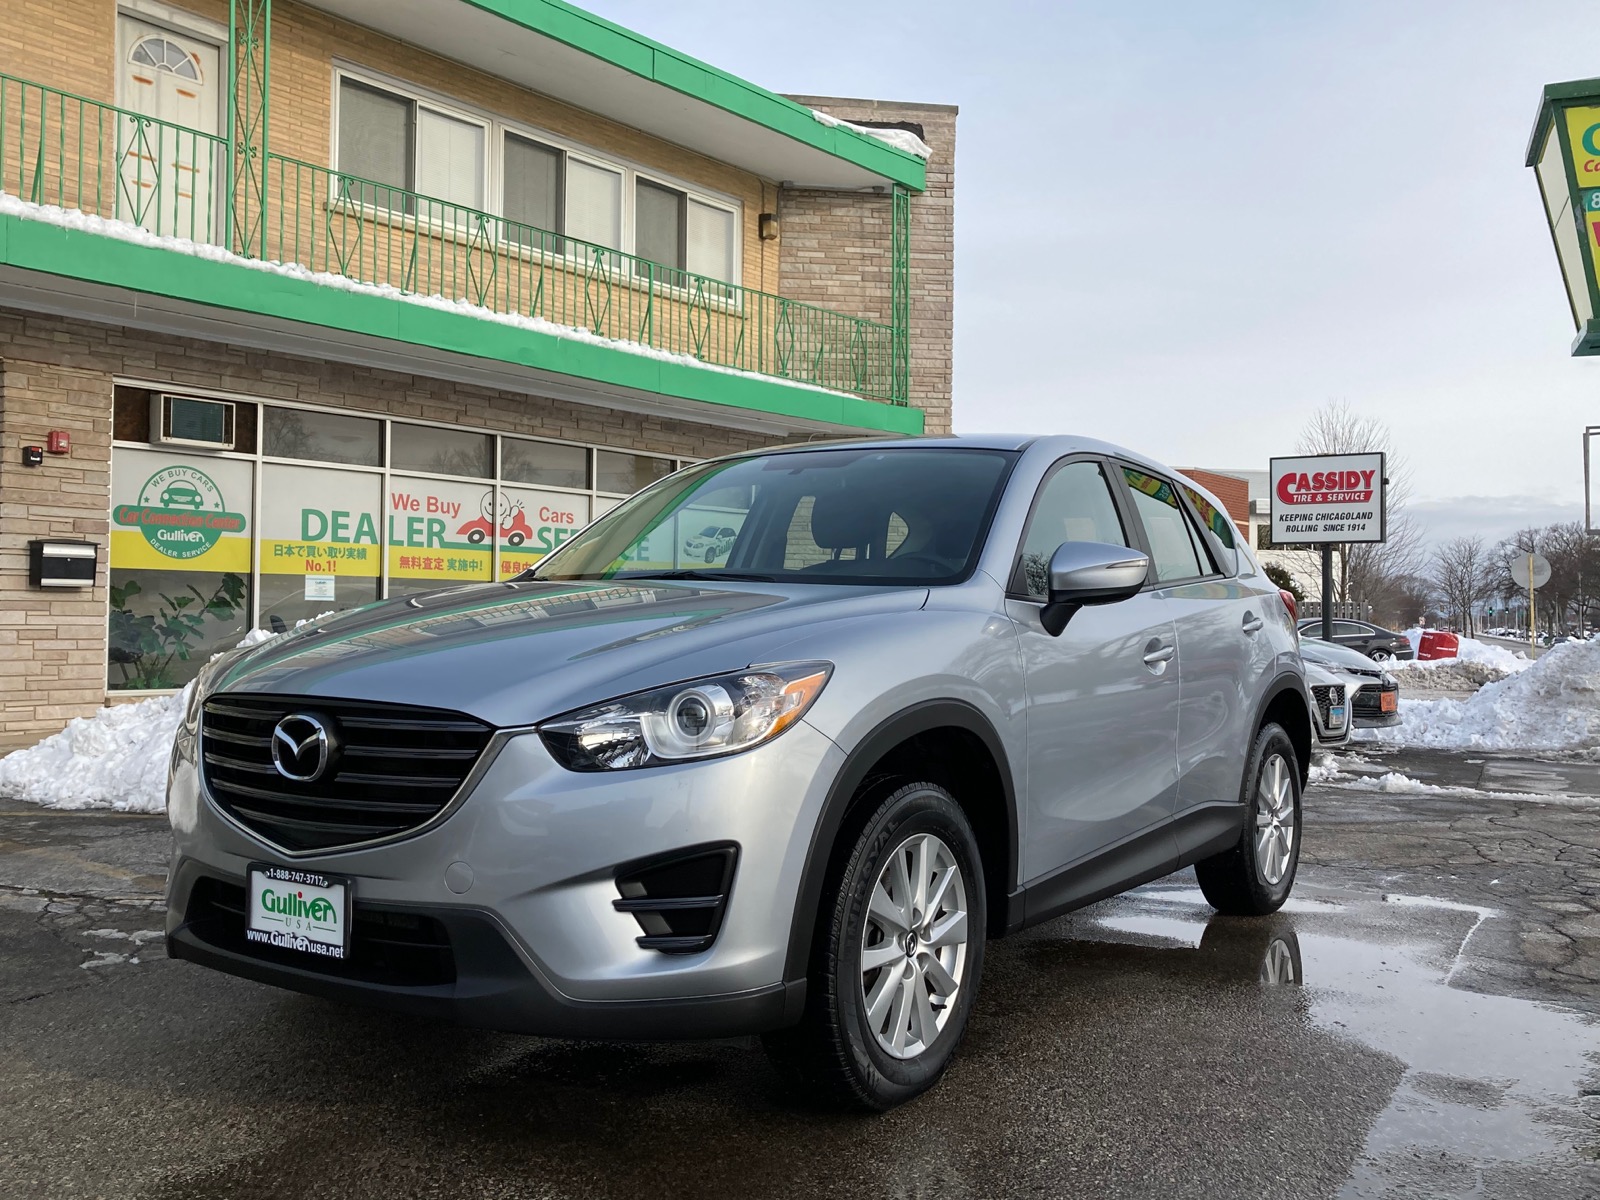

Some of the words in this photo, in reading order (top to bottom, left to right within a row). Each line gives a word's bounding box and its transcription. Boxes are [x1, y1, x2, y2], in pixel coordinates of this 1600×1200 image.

[151, 474, 166, 488] WE
[168, 469, 188, 478] BUY
[190, 471, 214, 493] CARS
[1276, 469, 1376, 498] CASSIDY
[1293, 494, 1313, 503] TIRE
[1315, 493, 1323, 502] &
[1327, 492, 1366, 502] SERVICE
[391, 492, 421, 512] We
[426, 495, 461, 519] Buy
[538, 506, 575, 524] Cars
[1279, 513, 1314, 522] KEEPING
[1315, 511, 1374, 522] CHICAGOLAND
[119, 506, 139, 523] Car
[141, 508, 204, 528] Connection
[205, 513, 241, 530] Center
[157, 528, 205, 543] Gulliver
[1285, 524, 1319, 533] ROLLING
[1322, 523, 1345, 532] SINCE
[1347, 523, 1366, 532] 1914
[149, 538, 178, 558] DEALER
[182, 541, 212, 558] SERVICE
[305, 559, 337, 573] No.1!
[270, 868, 324, 886] 1-888-747-3717
[261, 888, 338, 925] Gulliver
